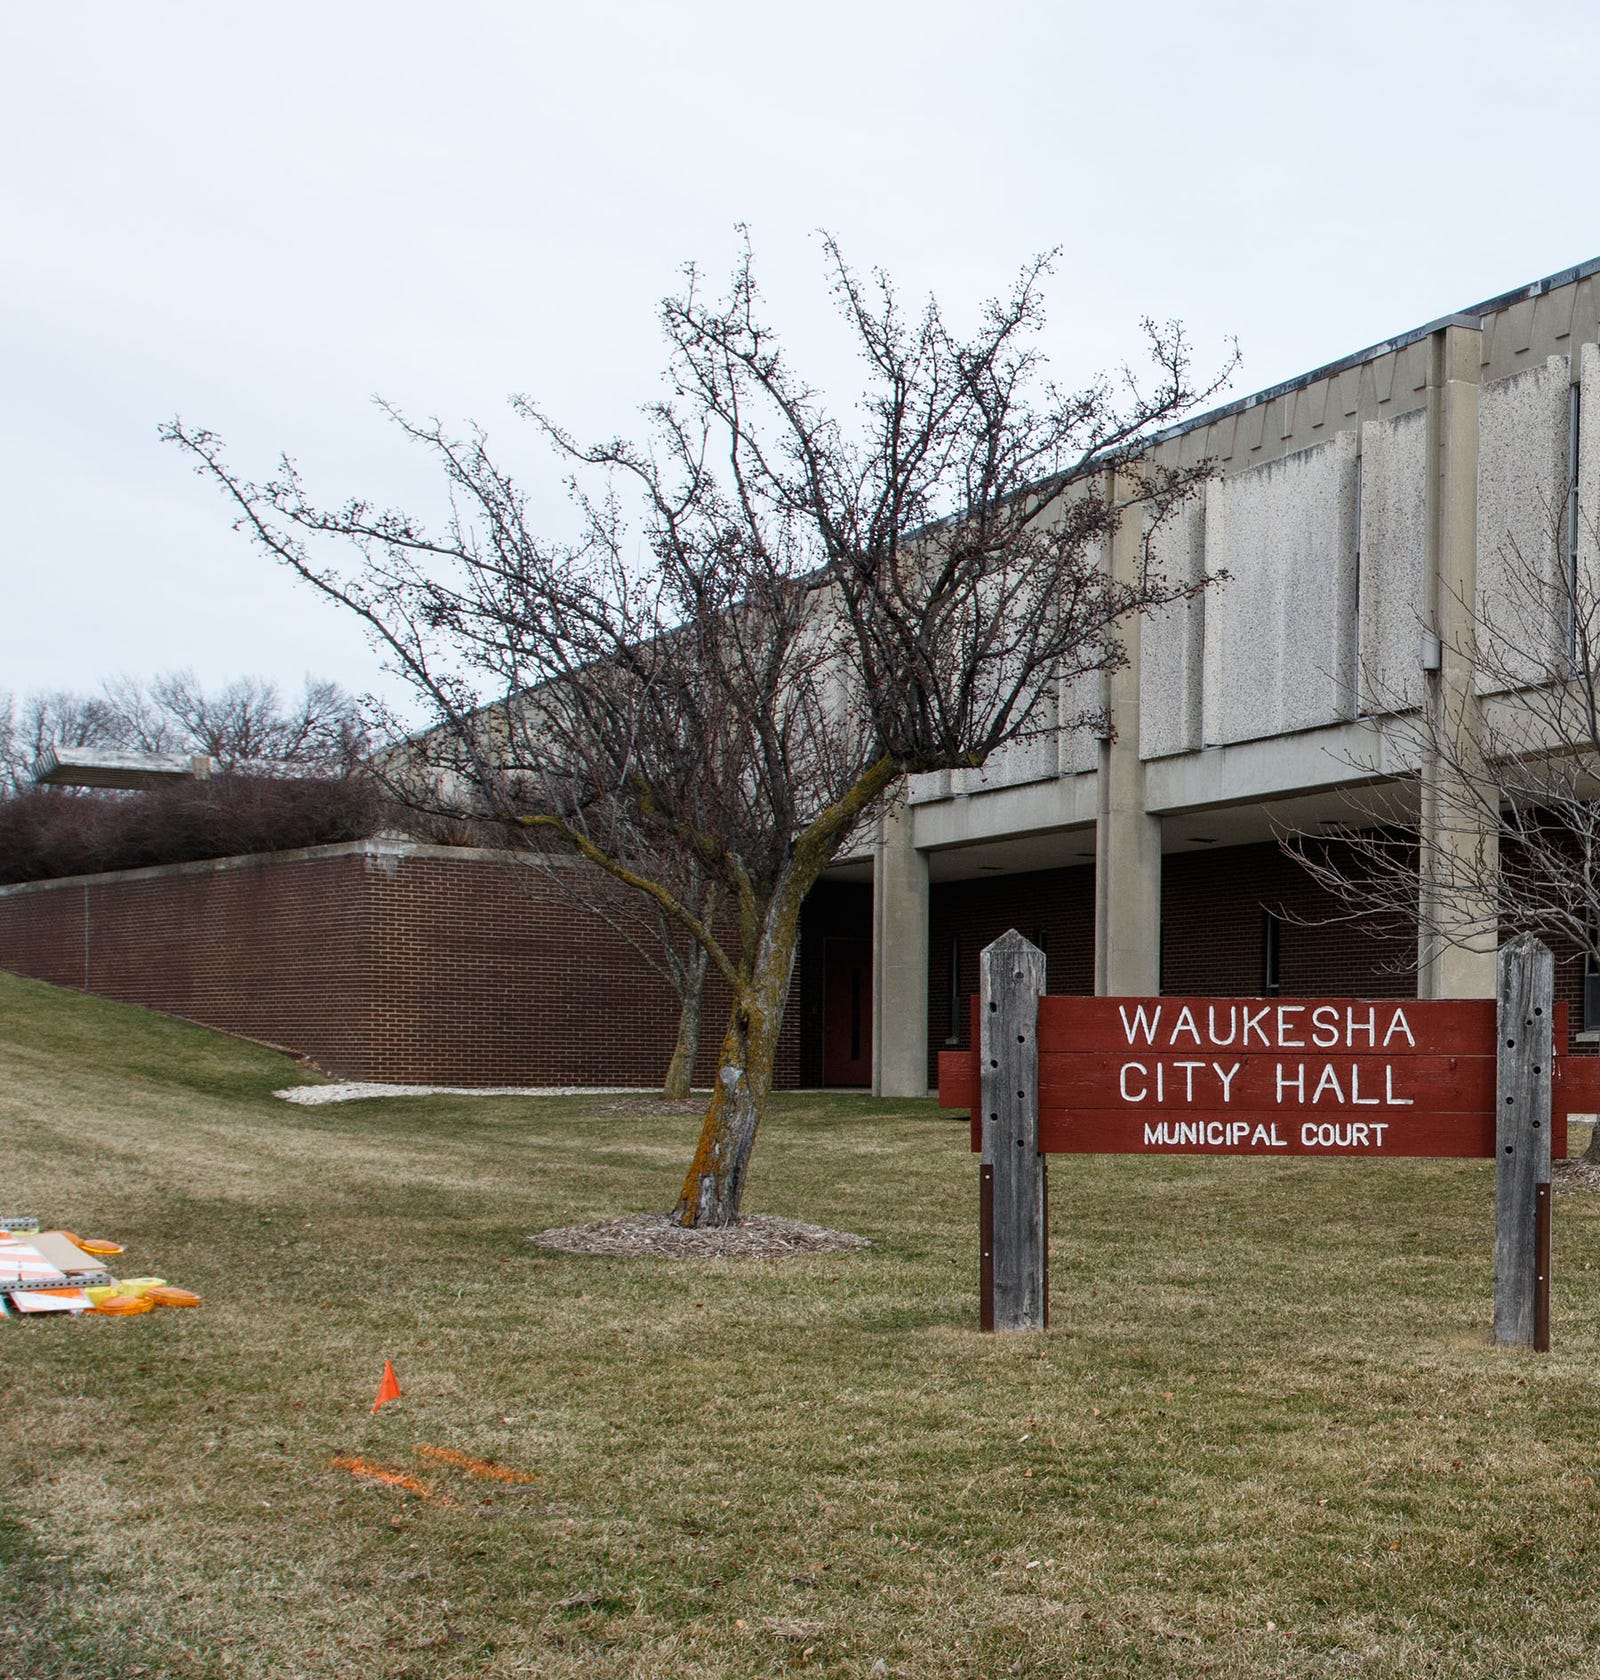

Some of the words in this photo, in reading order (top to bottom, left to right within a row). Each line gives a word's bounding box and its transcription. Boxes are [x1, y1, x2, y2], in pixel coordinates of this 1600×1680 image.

[1118, 1004, 1416, 1047] WAUKESHA
[1119, 1061, 1241, 1102] CITY
[1275, 1062, 1414, 1104] HALL
[1143, 1120, 1288, 1146] MUNICIPAL
[1300, 1121, 1389, 1147] COURT
